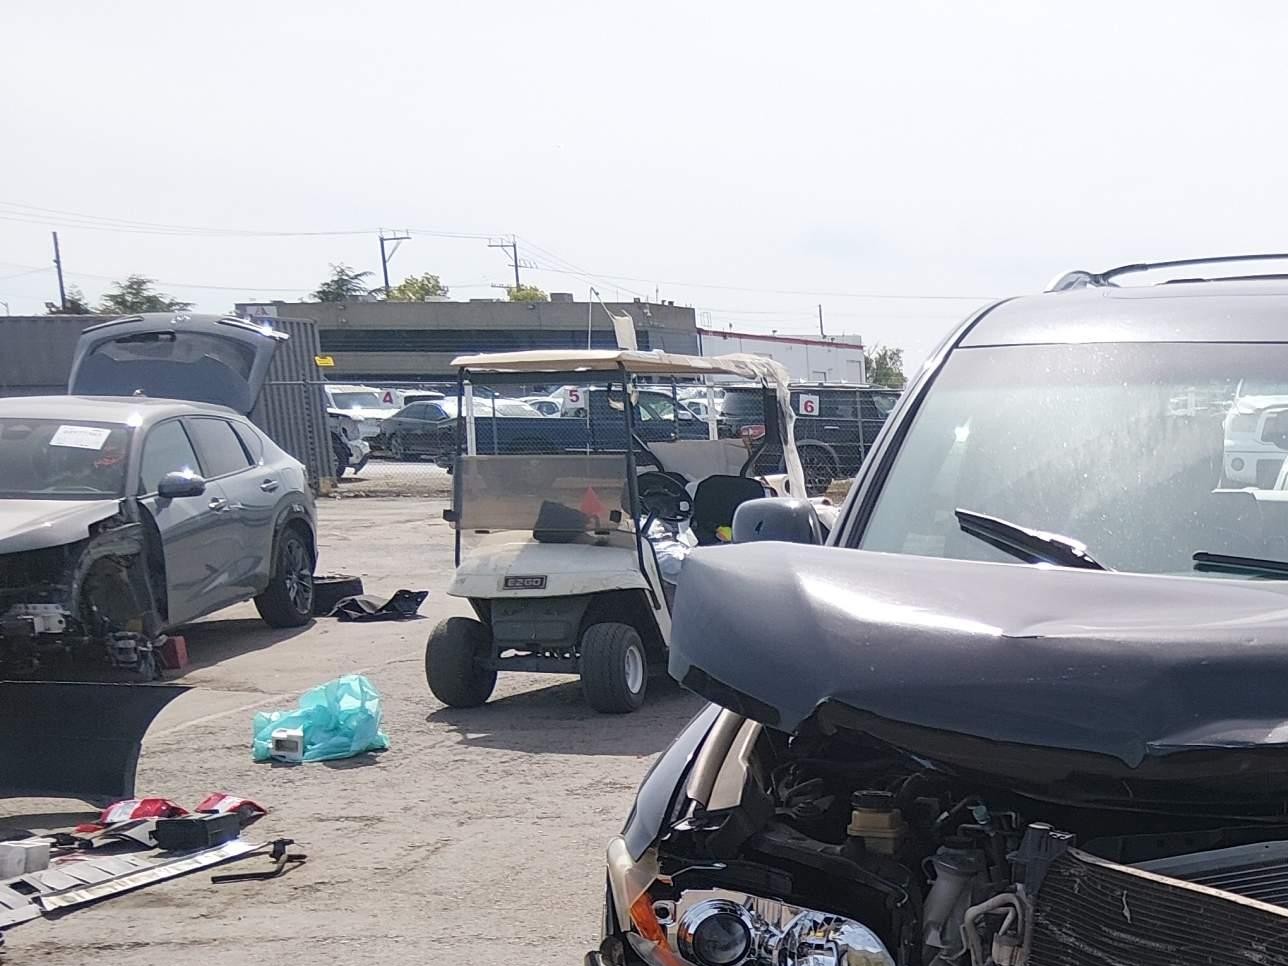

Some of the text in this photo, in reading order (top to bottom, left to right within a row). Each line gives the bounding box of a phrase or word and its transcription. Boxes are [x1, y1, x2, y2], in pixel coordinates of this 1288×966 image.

[383, 391, 394, 405] 4
[569, 389, 580, 403] 5
[803, 400, 815, 413] 6
